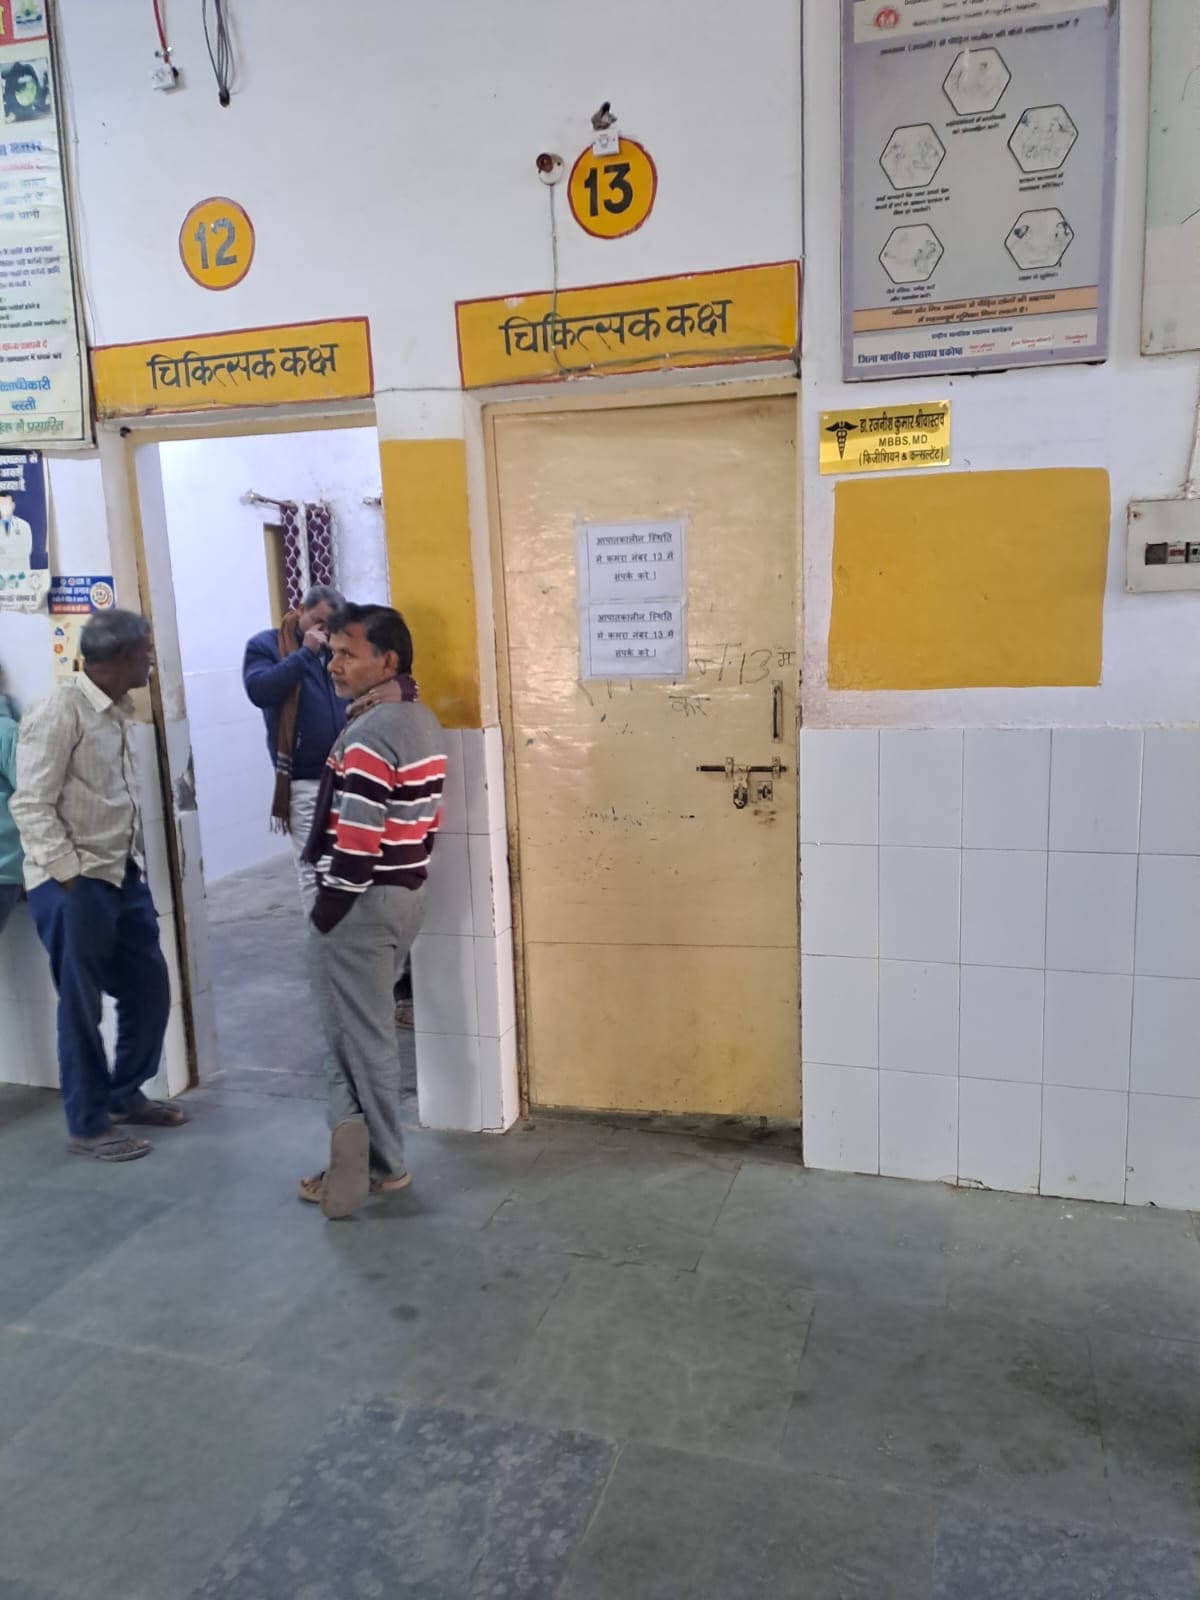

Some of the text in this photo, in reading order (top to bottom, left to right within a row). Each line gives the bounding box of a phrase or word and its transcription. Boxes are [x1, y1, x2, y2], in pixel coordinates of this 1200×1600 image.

[584, 162, 633, 217] 13
[194, 218, 238, 270] 12
[499, 299, 733, 356] चिकित्सक कक्ष
[146, 344, 339, 390] चिकित्सक कक्ष
[894, 415, 914, 435] कुमार
[915, 408, 944, 430] श्रीवास्तव
